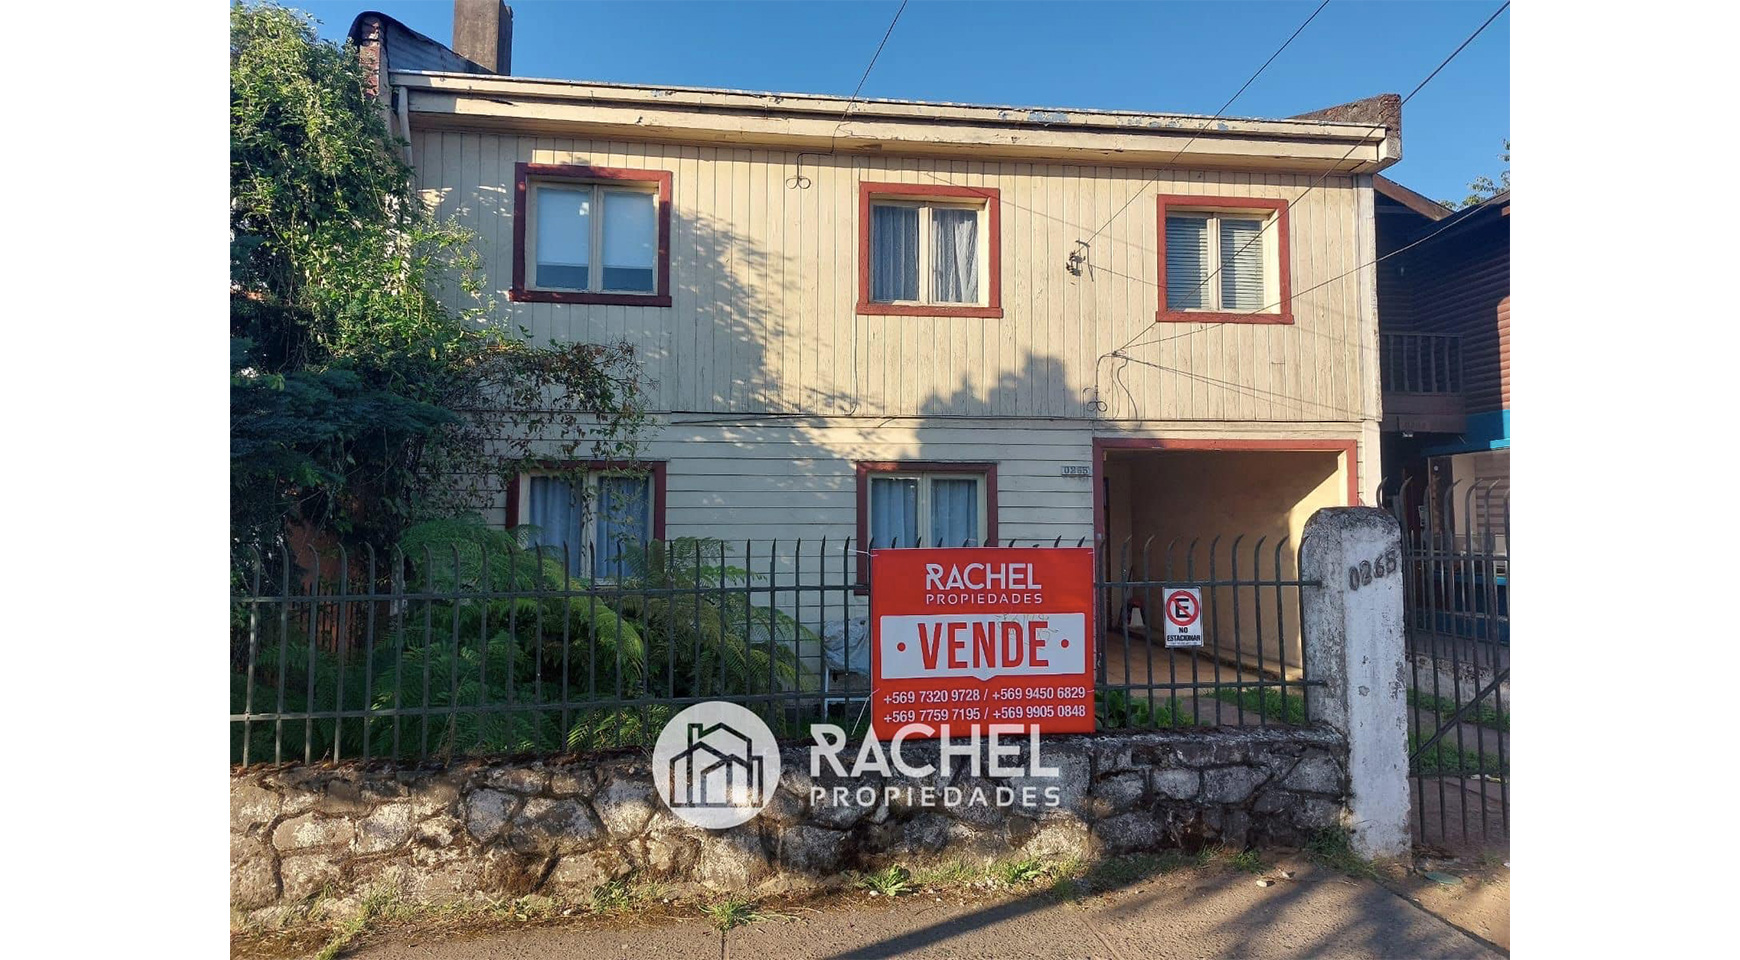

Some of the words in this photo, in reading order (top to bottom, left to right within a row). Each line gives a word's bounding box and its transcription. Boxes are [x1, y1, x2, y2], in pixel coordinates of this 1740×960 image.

[925, 563, 1042, 590] RACHEL
[926, 593, 1043, 605] PROPIEDADES
[1175, 598, 1189, 618] E
[917, 620, 1050, 670] VENDE
[884, 692, 915, 704] +569
[919, 691, 948, 703] 7320
[951, 689, 980, 702] 9728
[992, 688, 1022, 700] +569
[1025, 687, 1054, 699] 9450
[1057, 686, 1086, 699] 6829
[884, 710, 916, 723] +569
[919, 709, 949, 722] 7759
[952, 708, 980, 720] 7195
[992, 707, 1024, 719] +569
[1026, 706, 1054, 718] 9905
[1057, 705, 1086, 717] 0848
